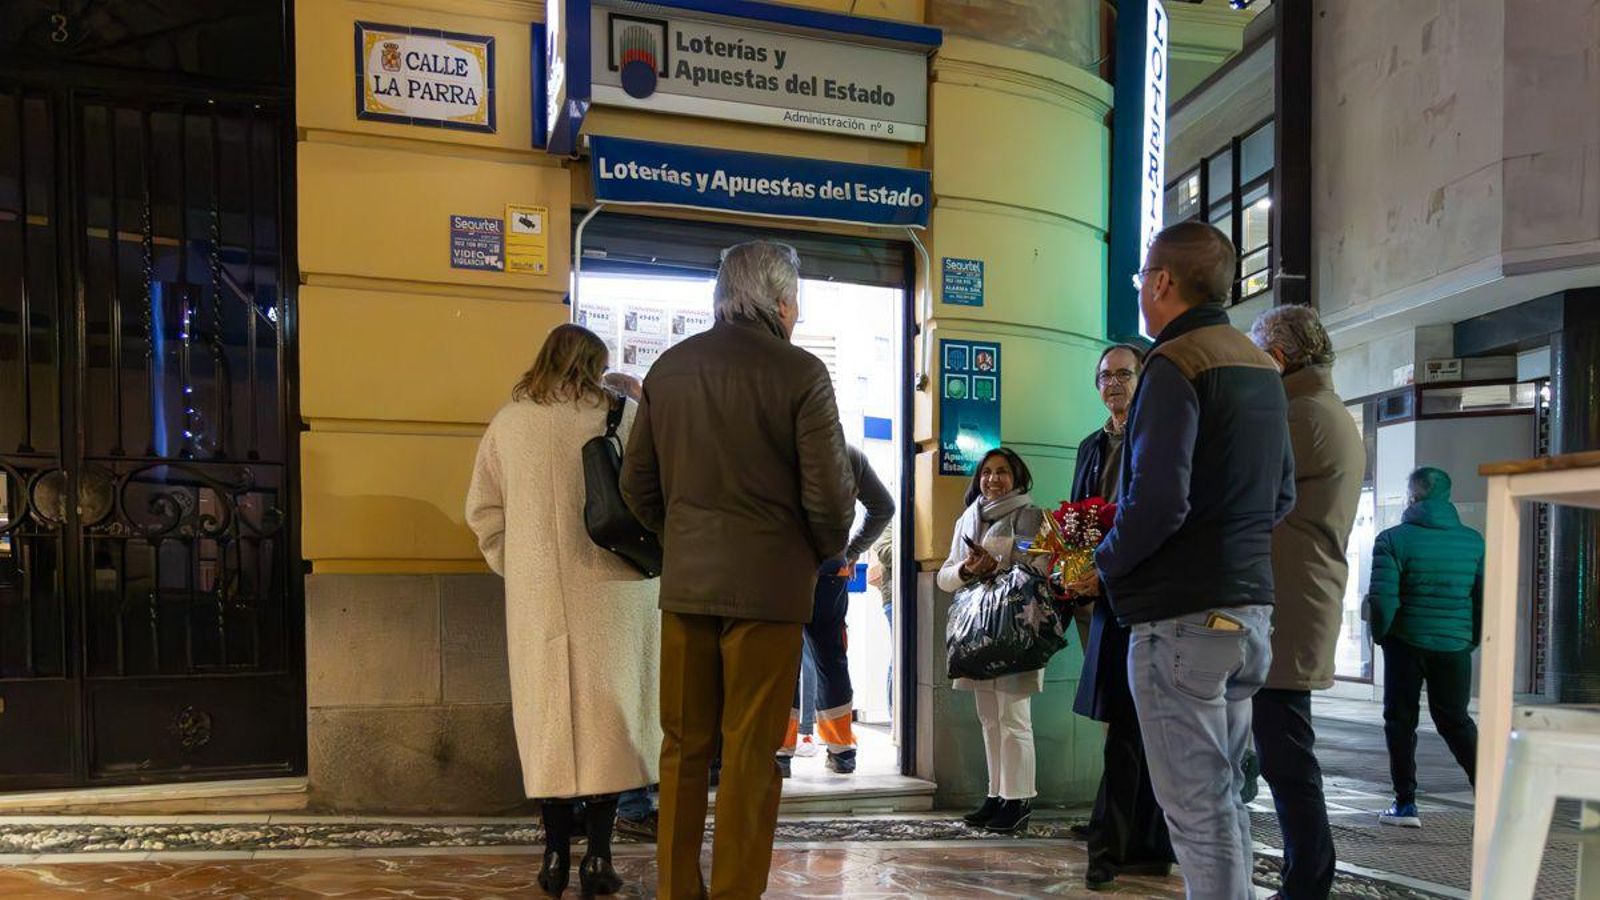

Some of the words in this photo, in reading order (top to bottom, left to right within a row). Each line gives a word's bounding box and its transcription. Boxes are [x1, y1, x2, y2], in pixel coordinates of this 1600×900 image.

[51, 14, 69, 42] 3
[676, 31, 767, 62] Loterías
[774, 49, 787, 69] y
[405, 51, 469, 78] CALLE
[373, 75, 401, 97] LA
[407, 79, 479, 106] PARRA
[675, 59, 780, 92] Apuestas
[785, 72, 817, 97] del
[824, 79, 896, 107] Estado
[783, 110, 865, 132] Administración
[870, 122, 882, 133] nº
[887, 124, 895, 134] 8
[599, 156, 691, 187] Loterías
[696, 173, 709, 192] y
[711, 169, 815, 199] Apuestas
[819, 180, 850, 201] del
[854, 183, 924, 208] Estado
[455, 216, 500, 235] Segurtel
[453, 249, 485, 259] VIDEO
